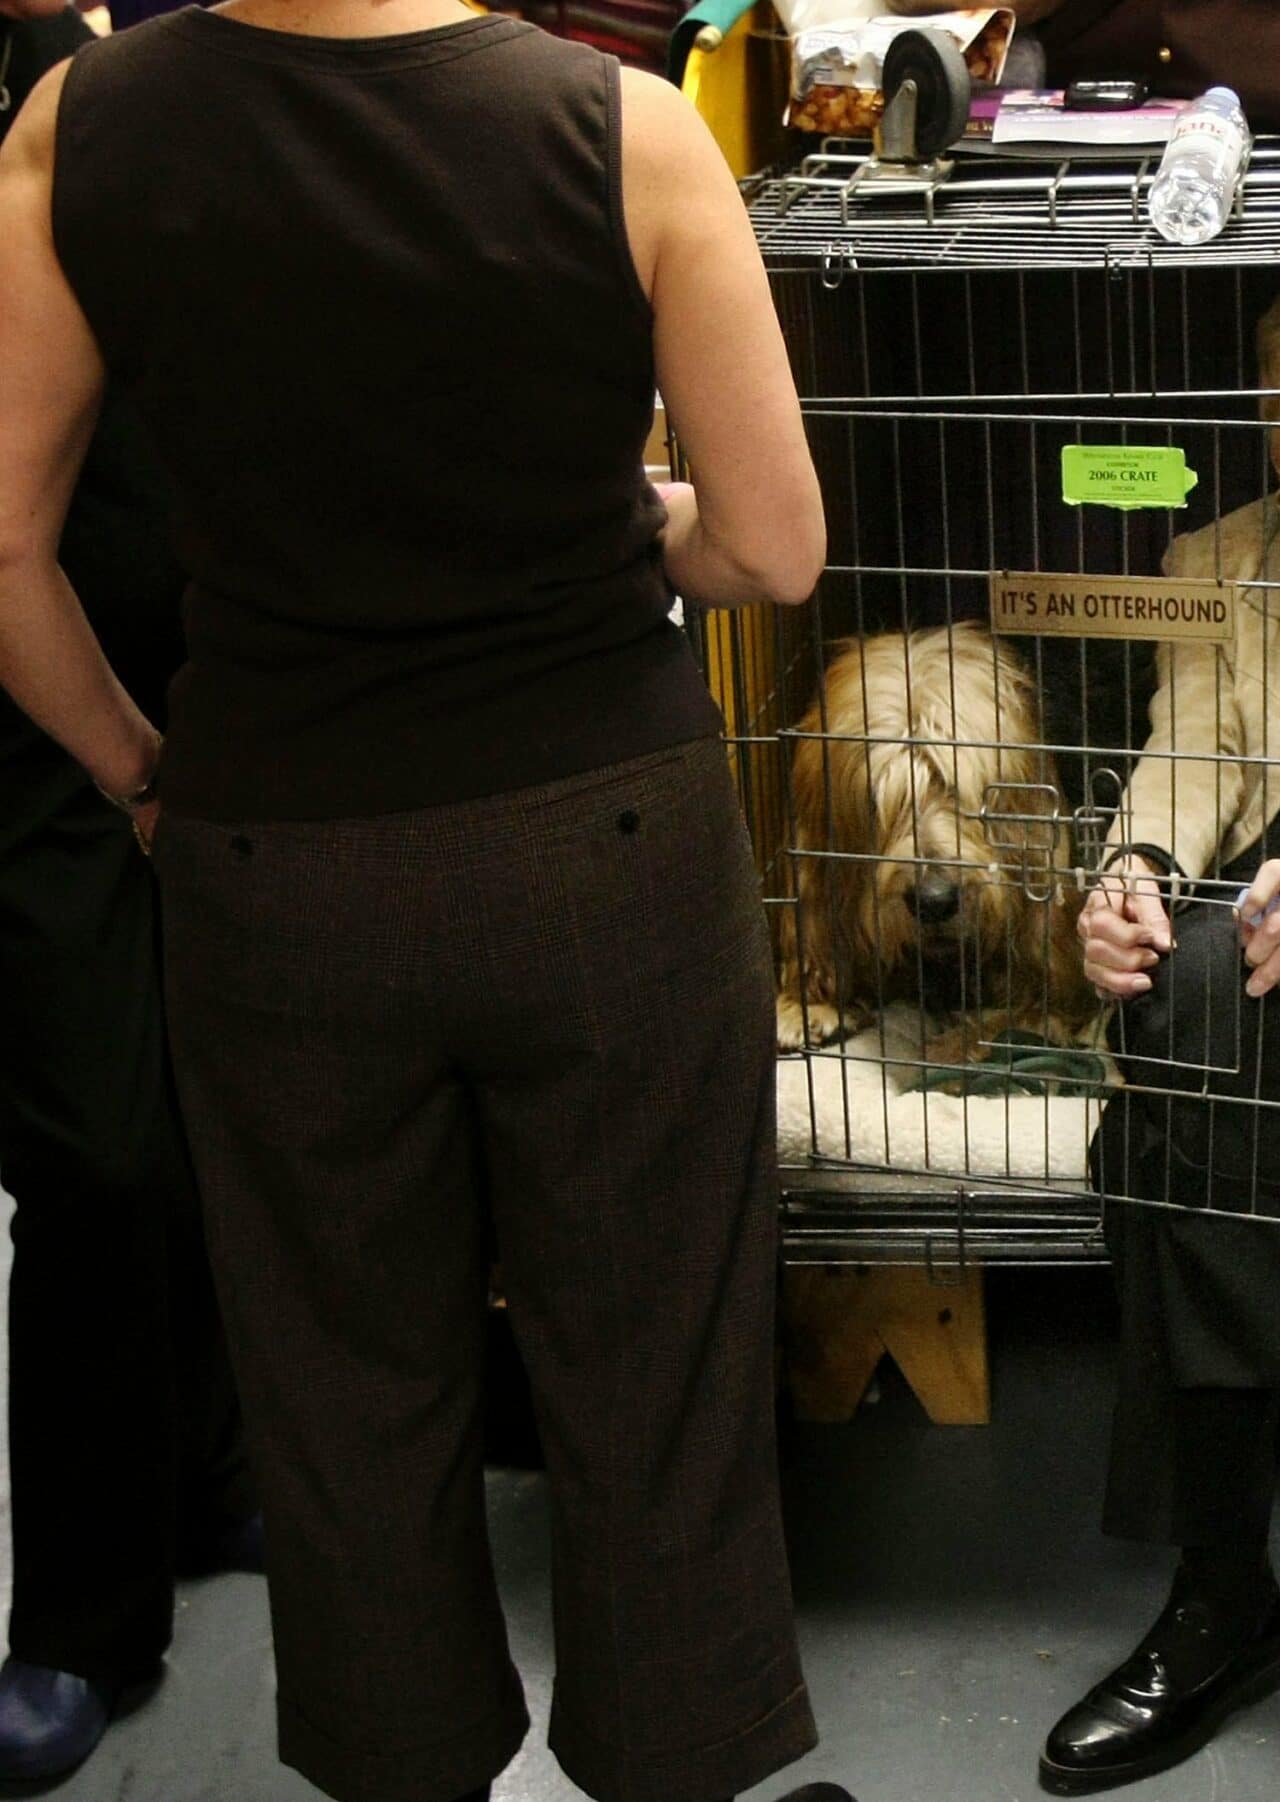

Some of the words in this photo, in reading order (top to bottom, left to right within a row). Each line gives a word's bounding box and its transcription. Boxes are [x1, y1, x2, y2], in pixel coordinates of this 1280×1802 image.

[1088, 470, 1118, 481] 2006
[1120, 470, 1159, 482] CRATE
[1000, 591, 1038, 615] IT'S
[1046, 593, 1075, 617] AN
[1083, 595, 1227, 624] OTTERHOUND
